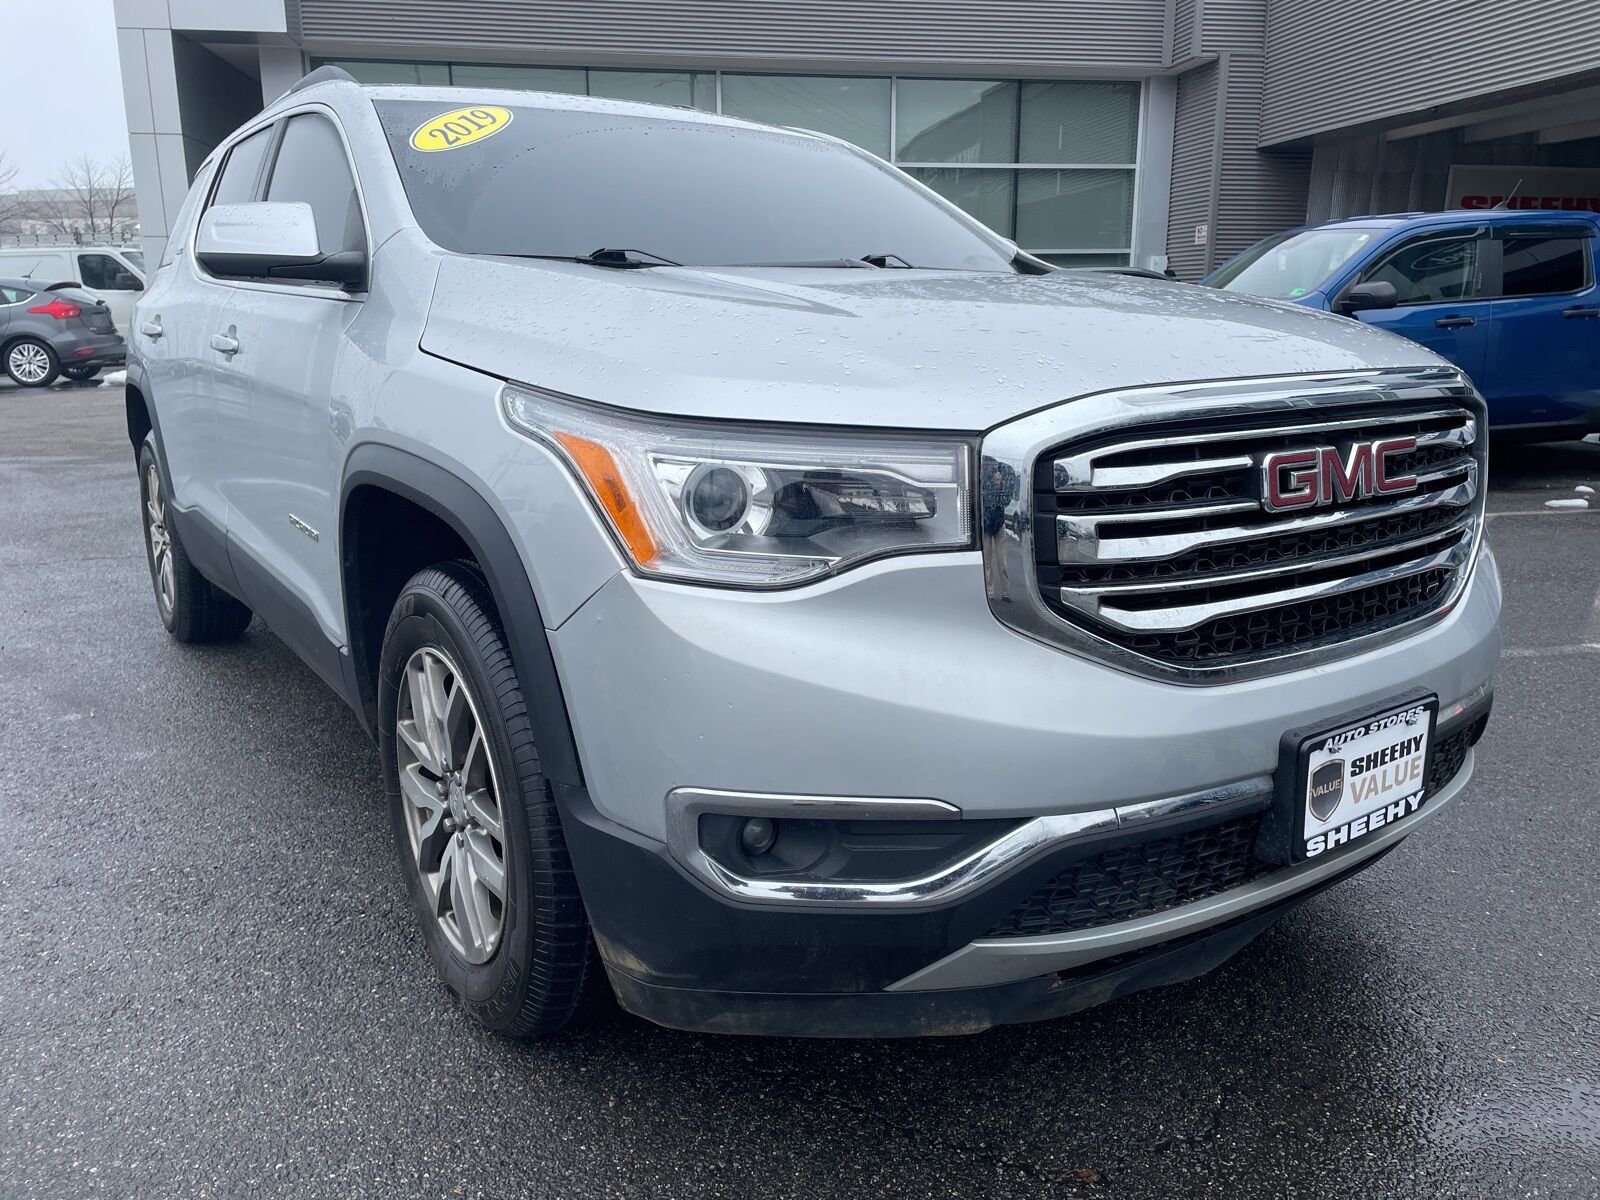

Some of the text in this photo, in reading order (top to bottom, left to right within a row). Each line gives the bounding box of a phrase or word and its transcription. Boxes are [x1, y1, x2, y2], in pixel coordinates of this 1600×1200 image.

[429, 110, 497, 145] 2019
[1461, 196, 1600, 210] SHEEH
[1262, 436, 1418, 514] GMC
[1324, 706, 1424, 749] AUTO STORES
[1351, 733, 1424, 777] SHEEHY
[1311, 779, 1341, 798] VALUE
[1350, 755, 1422, 804] VALUE
[1306, 790, 1425, 858] SHEEHY
